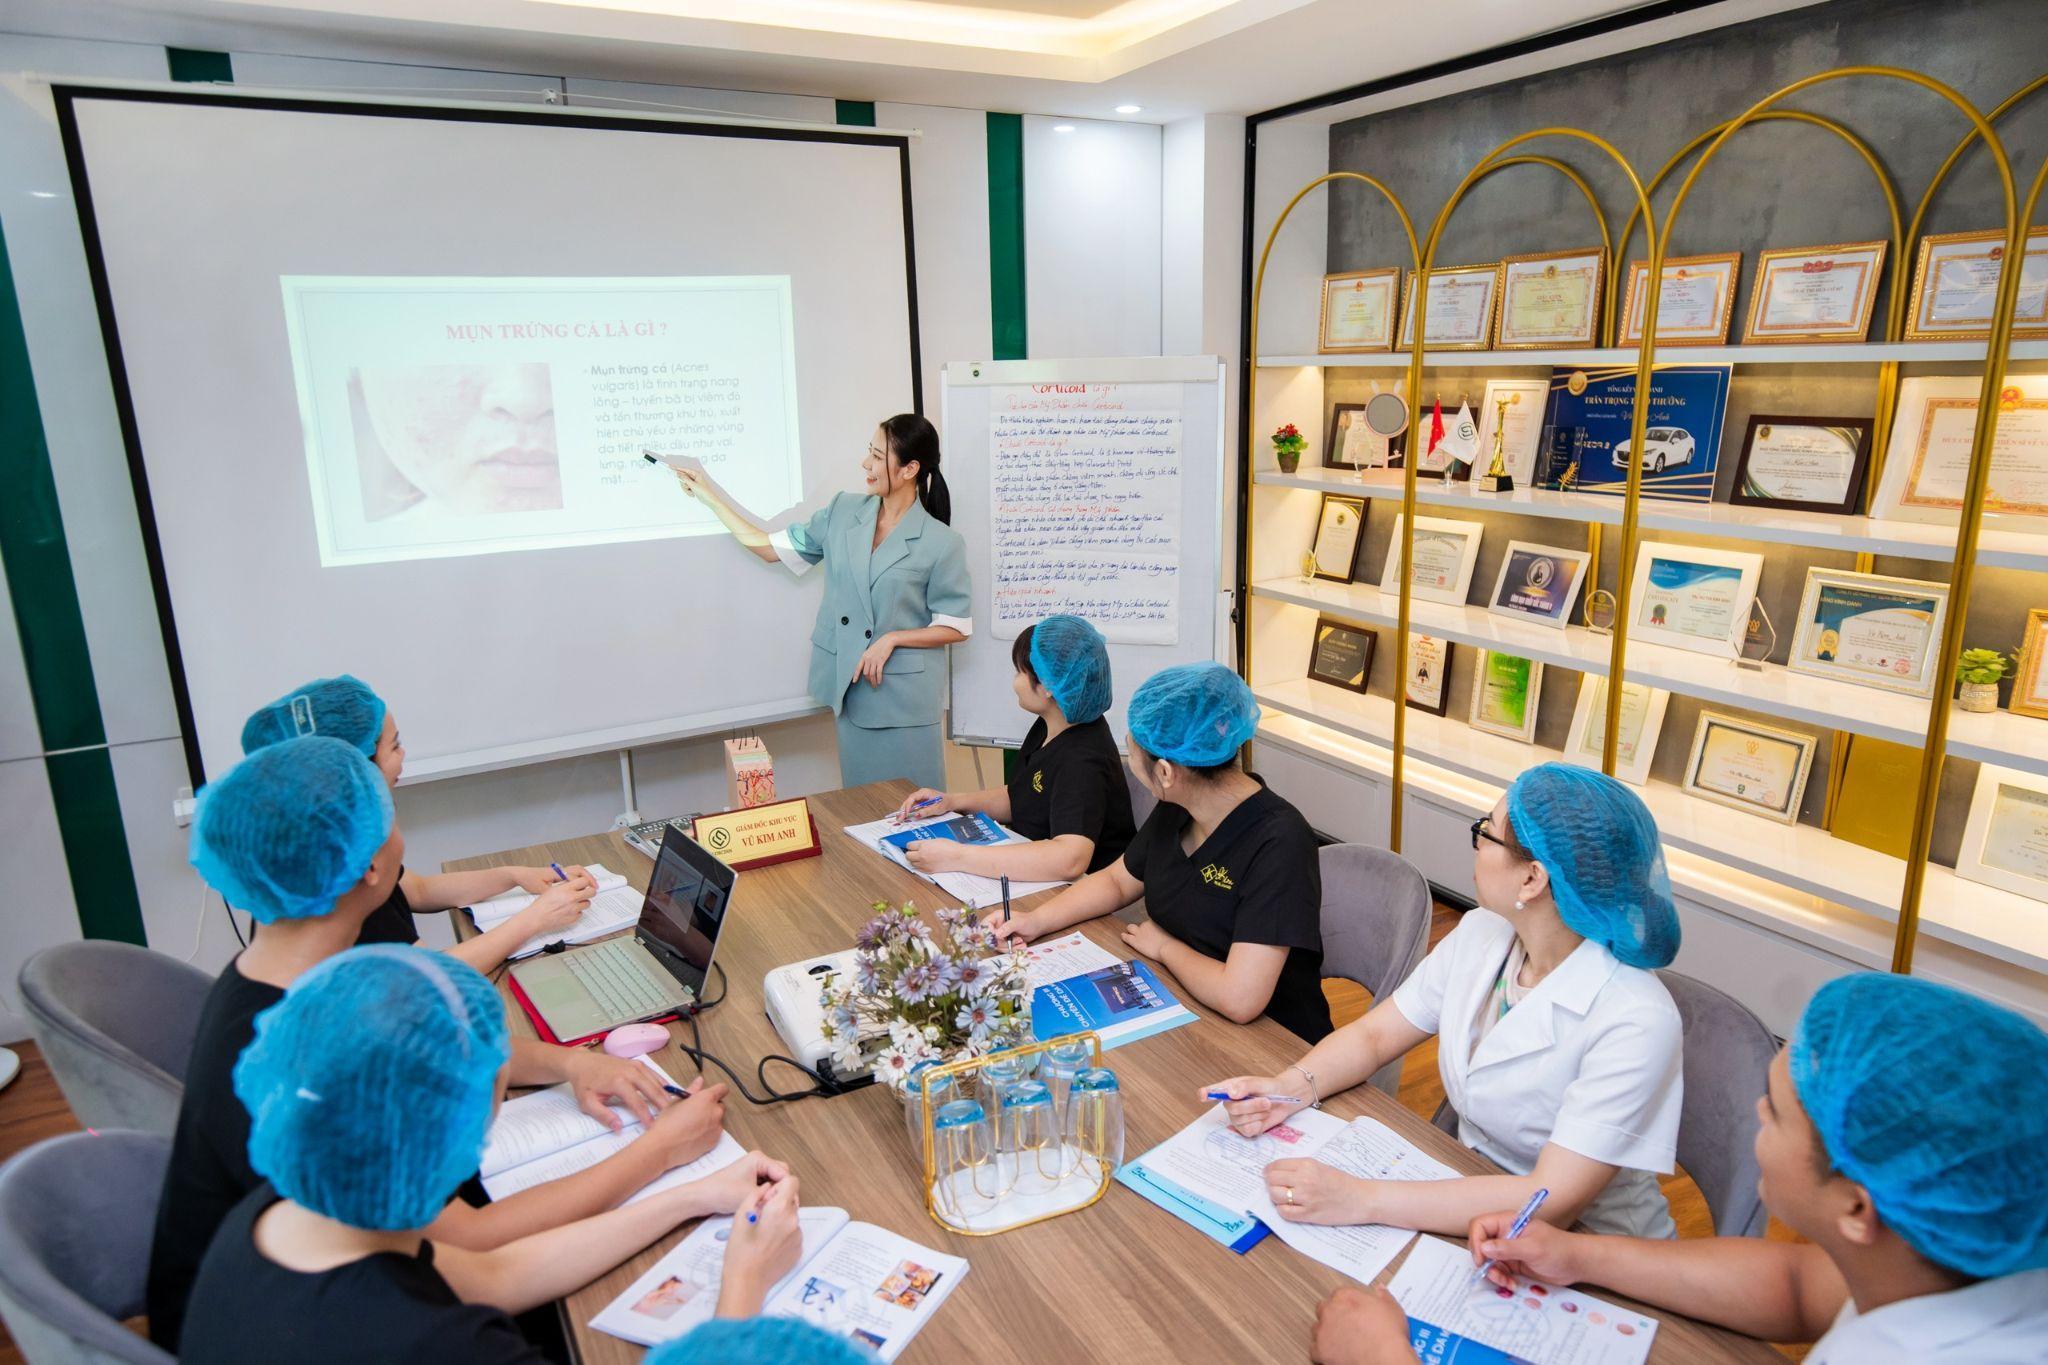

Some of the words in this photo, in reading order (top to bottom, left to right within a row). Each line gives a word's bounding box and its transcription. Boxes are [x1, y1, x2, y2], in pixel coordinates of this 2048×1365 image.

[446, 324, 493, 343] MỤN
[497, 320, 568, 339] TRỨNG
[606, 319, 629, 337] LÀ
[635, 319, 654, 336] GÌ
[659, 322, 668, 336] ?
[591, 365, 615, 377] Mụn
[652, 362, 667, 374] cá
[592, 381, 639, 393] vulgaris)
[1604, 396, 1629, 406] TRỌNG
[598, 444, 615, 454] da
[736, 824, 752, 832] GIÁM
[754, 820, 767, 829] ĐỐC
[769, 818, 782, 826] KHU
[784, 815, 797, 823] VỰC
[742, 835, 754, 846] VŨ
[757, 833, 775, 845] KIM
[777, 828, 795, 840] ANH
